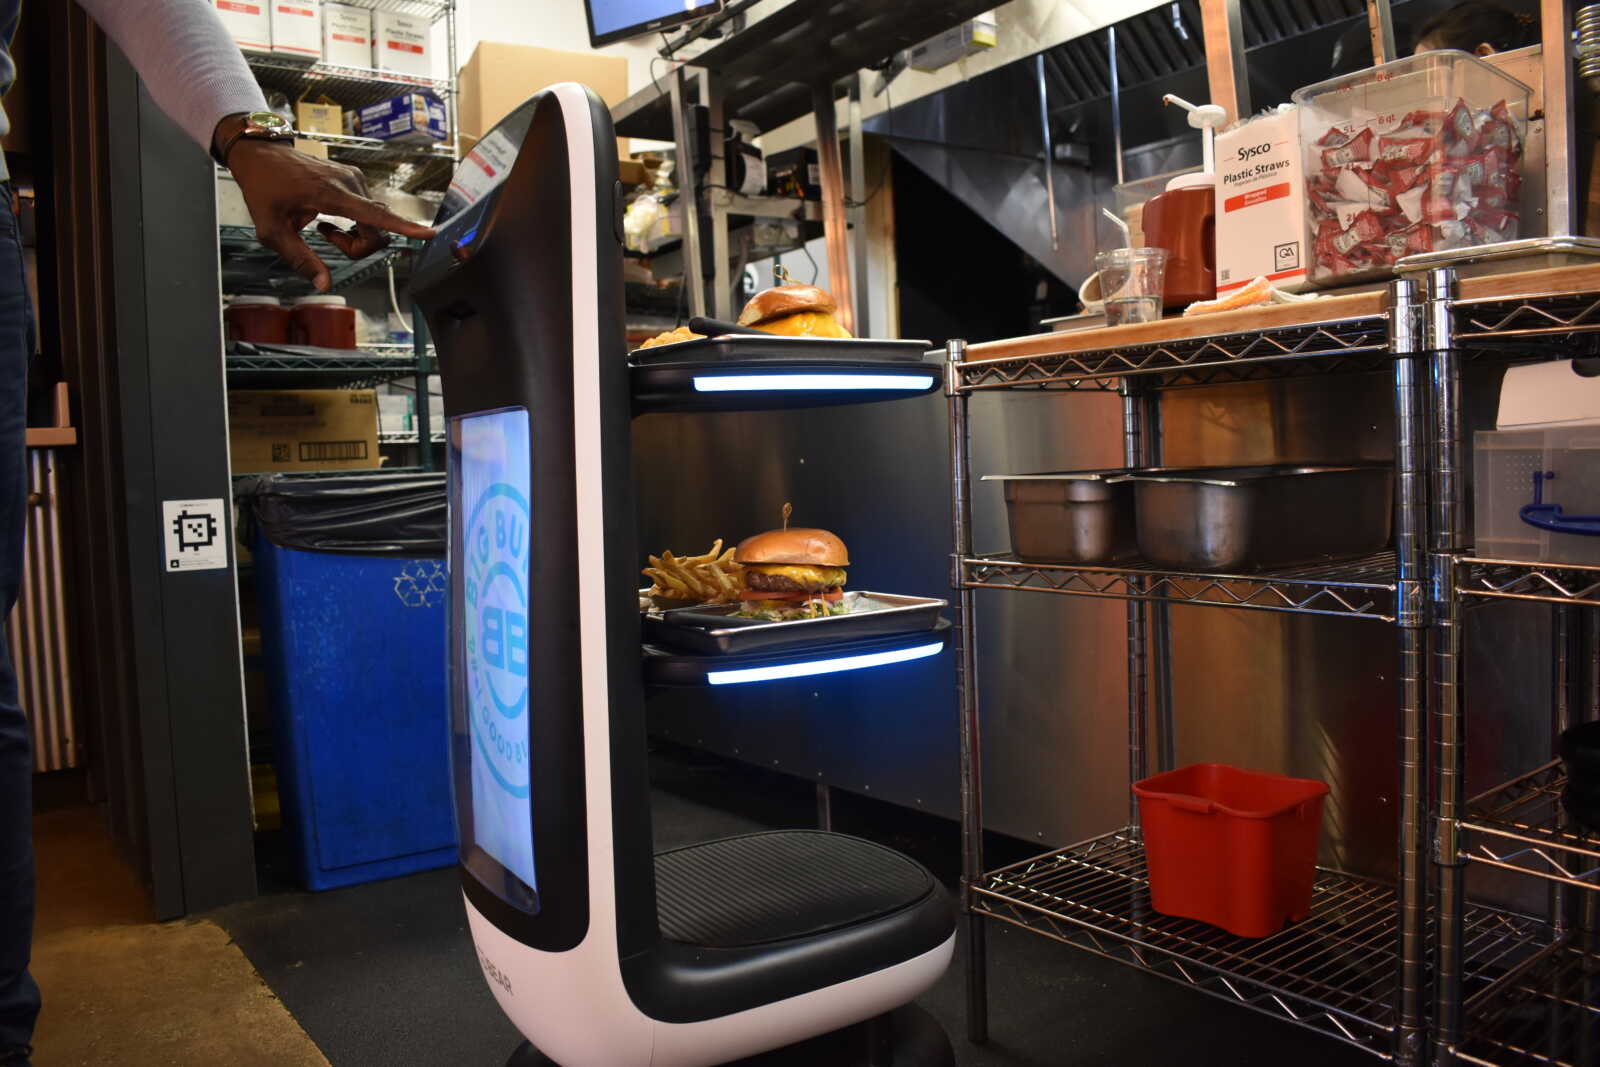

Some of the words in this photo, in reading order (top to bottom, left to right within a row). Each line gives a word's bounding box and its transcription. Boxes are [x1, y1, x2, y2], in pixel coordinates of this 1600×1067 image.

[1237, 143, 1272, 162] Sysco
[1223, 167, 1254, 185] Plastic
[1255, 159, 1291, 176] Straws
[465, 525, 489, 608] BIG
